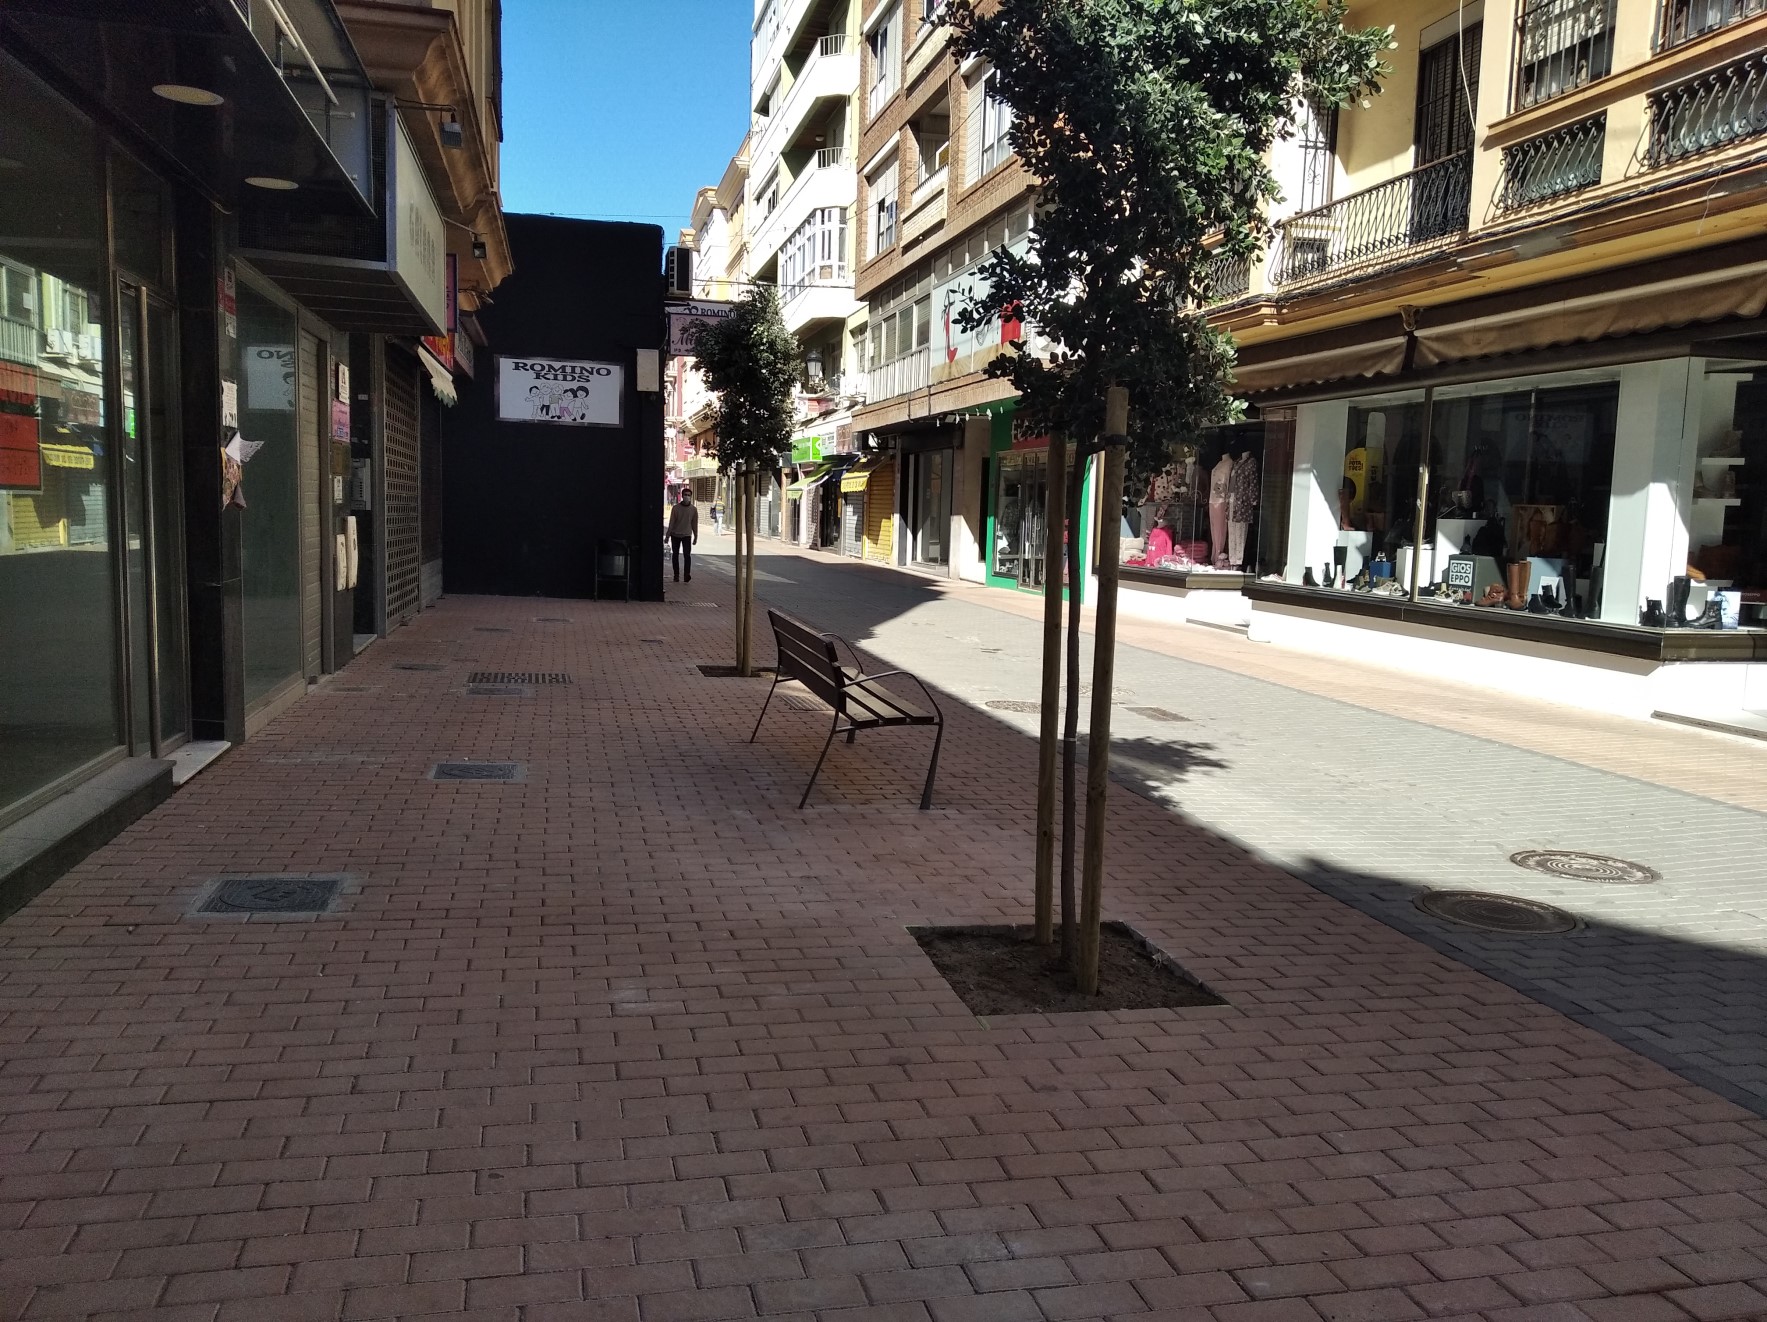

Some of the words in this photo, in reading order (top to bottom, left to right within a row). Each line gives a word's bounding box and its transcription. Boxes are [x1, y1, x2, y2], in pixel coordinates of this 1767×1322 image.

[700, 308, 737, 319] ROMINO
[512, 361, 612, 377] ROMINO
[533, 371, 591, 383] KIDS
[1451, 563, 1471, 574] GIOS
[1450, 574, 1470, 584] EPPO
